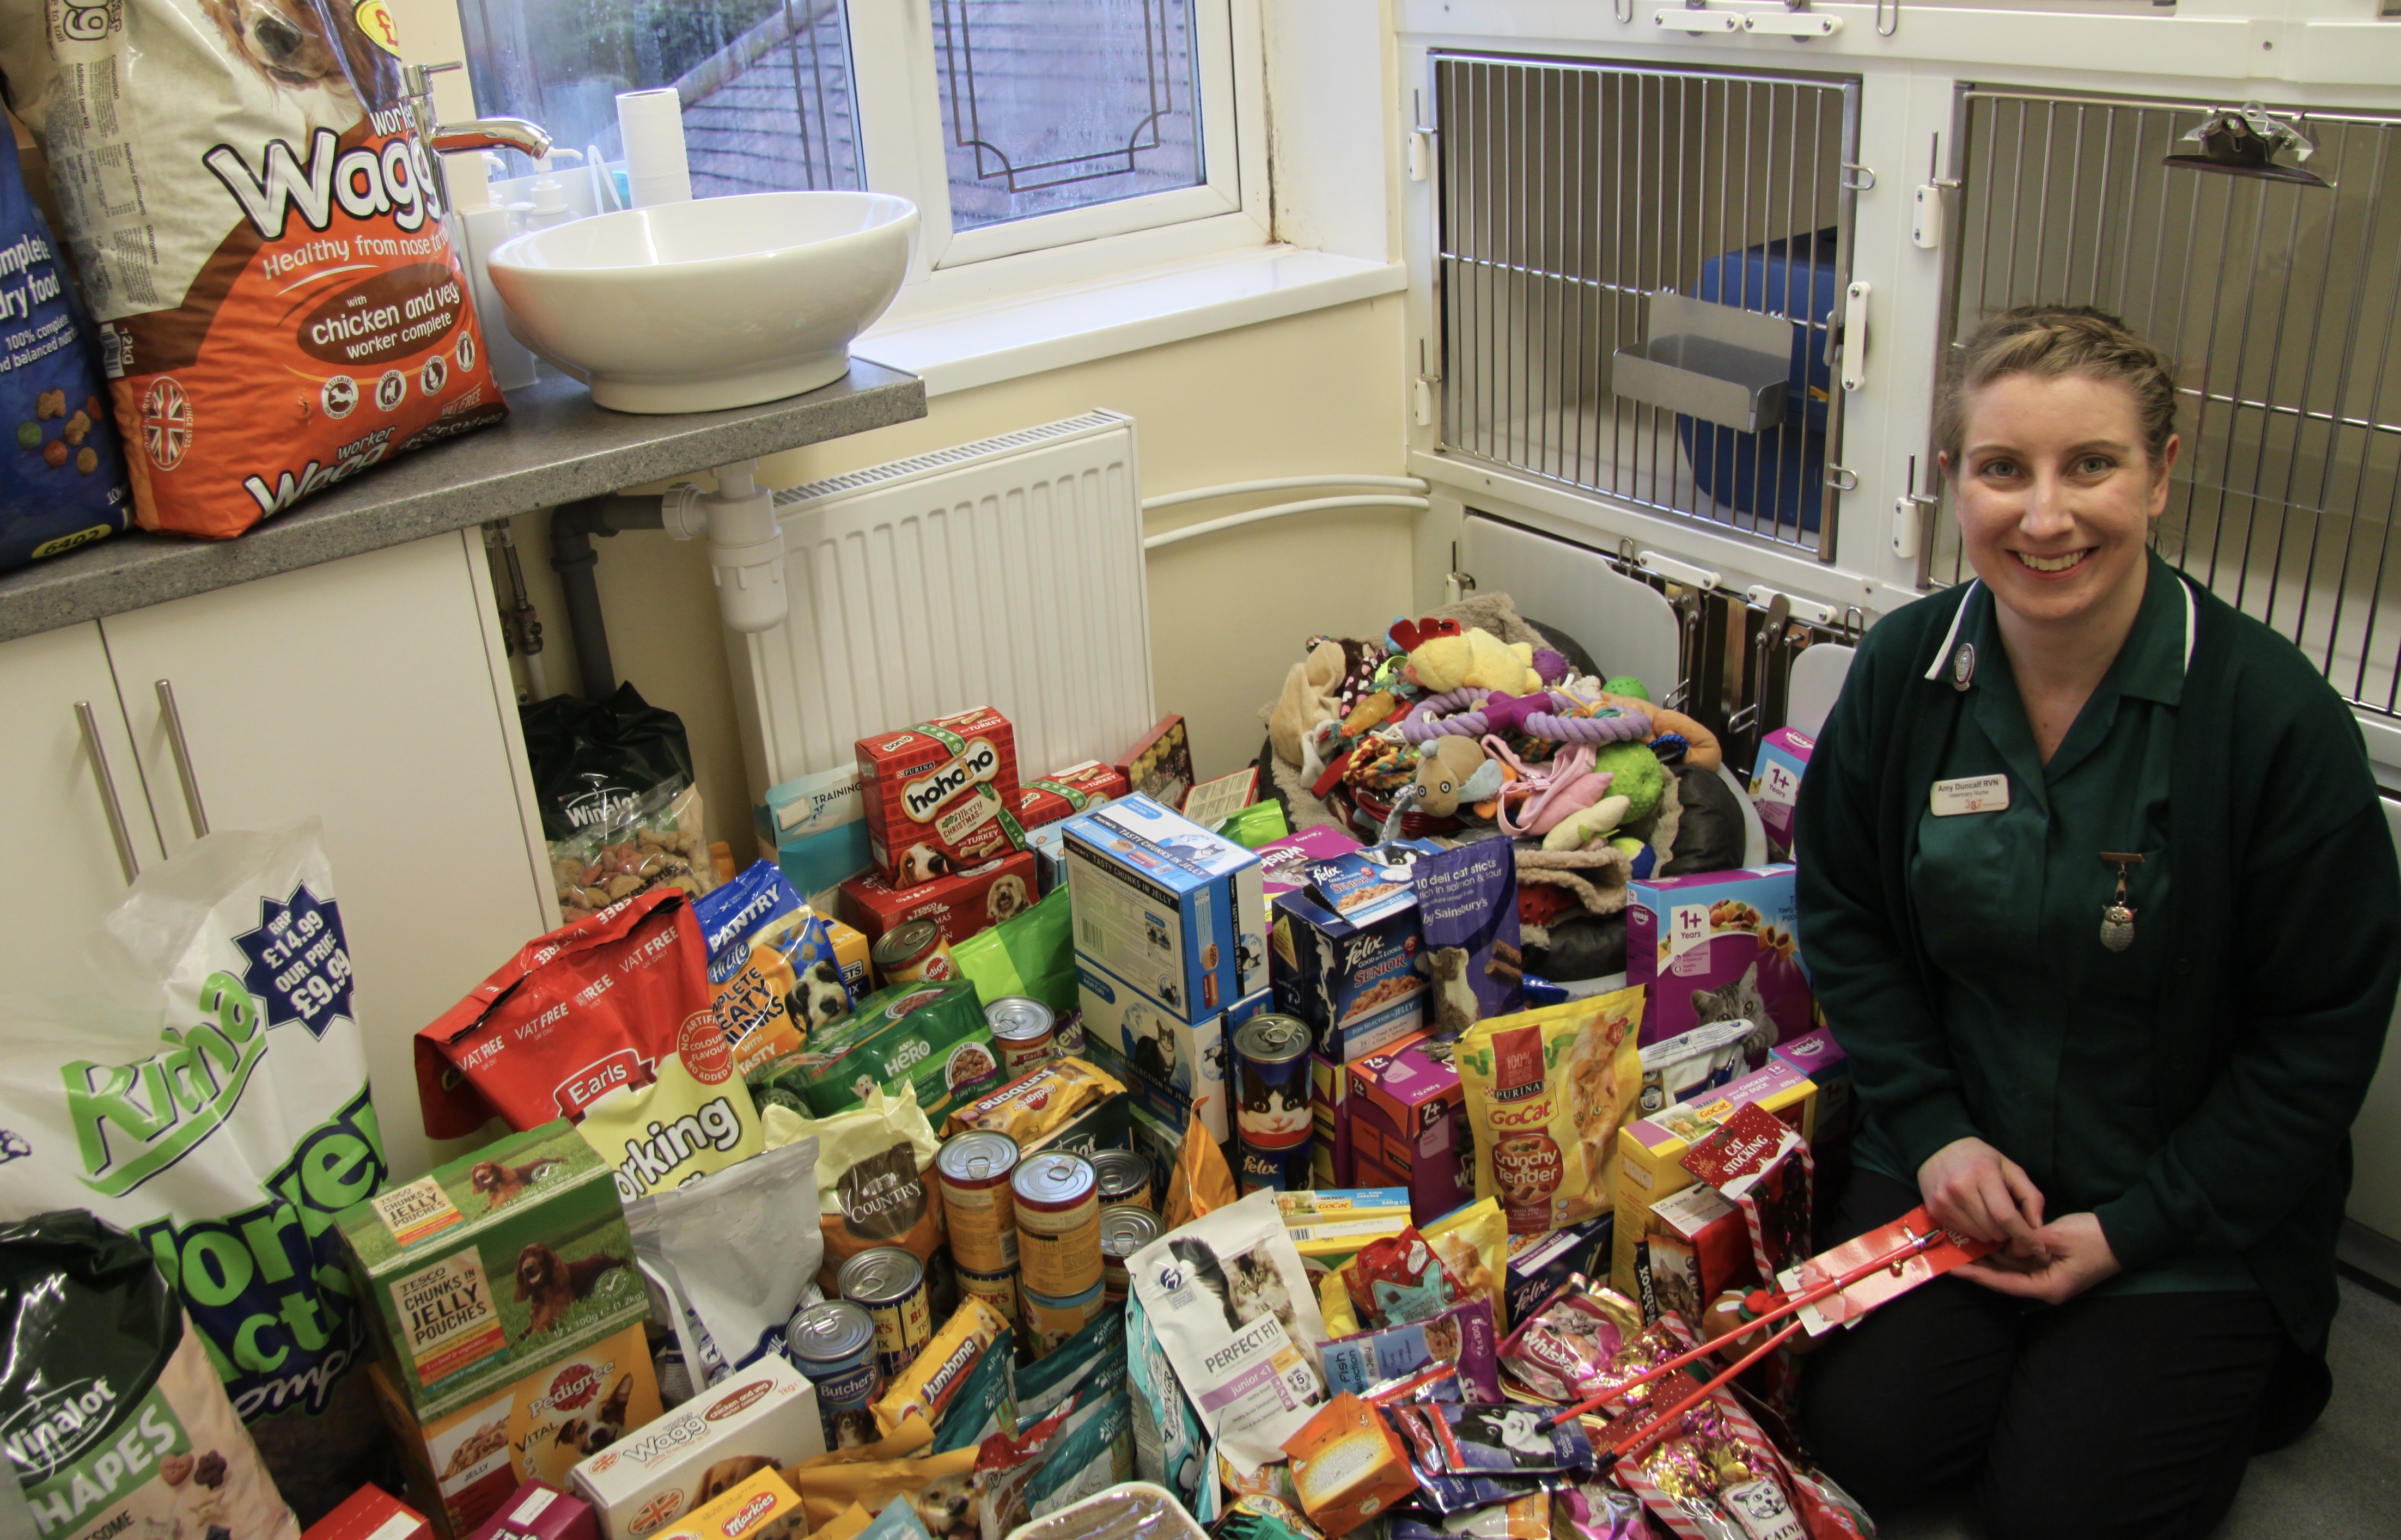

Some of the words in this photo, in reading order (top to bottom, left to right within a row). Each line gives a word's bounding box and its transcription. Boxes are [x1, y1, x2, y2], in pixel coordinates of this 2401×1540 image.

[202, 127, 442, 240] Wagg
[147, 225, 159, 265] Guarantee
[263, 239, 350, 280] Healthy
[355, 235, 399, 256] from
[400, 239, 431, 256] nose
[27, 268, 60, 304] food
[312, 304, 400, 345] chicken
[405, 288, 436, 320] and
[435, 280, 460, 305] veg
[347, 295, 368, 308] with
[5, 329, 36, 351] 100%
[36, 314, 70, 339] complete
[346, 331, 398, 359] worker
[402, 312, 452, 343] complete
[13, 337, 59, 368] balanced
[119, 328, 135, 365] 12kg
[330, 376, 354, 388] VITAMINS
[381, 371, 400, 382] STAMINA
[142, 391, 151, 410] MADE
[459, 387, 482, 414] FREE
[184, 402, 193, 427] SINCE
[184, 428, 193, 449] 1923
[338, 425, 397, 461] worker
[44, 529, 100, 555] 6402
[968, 718, 1002, 733] TURKEY
[905, 762, 934, 776] PURINA
[1088, 774, 1117, 788] TURKEY
[1772, 768, 1790, 789] 1+
[812, 781, 863, 806] TRAINING
[1769, 783, 1787, 799] Years
[954, 800, 983, 820] Merry
[943, 811, 982, 838] CHRISTMAS
[966, 829, 999, 846] TURKEY
[1119, 828, 1142, 845] TASTY
[1140, 840, 1173, 859] CHUNKS
[1170, 855, 1181, 864] IN
[1179, 861, 1206, 877] JELLY
[1092, 855, 1113, 871] TASTY
[1113, 867, 1141, 887] CHUNKS
[1142, 883, 1150, 894] IN
[1151, 888, 1172, 905] JELLY
[1313, 864, 1342, 886] felix
[1330, 875, 1373, 894] SENIOR
[1415, 878, 1428, 890] 10
[1429, 872, 1451, 886] deli
[1453, 866, 1468, 881] cat
[1470, 859, 1497, 874] sticks
[1419, 888, 1434, 900] rich
[1435, 885, 1444, 894] in
[1446, 877, 1476, 893] salmon
[1477, 873, 1485, 883] &
[268, 909, 292, 936] RRP
[596, 896, 633, 925] FREE
[709, 883, 783, 954] PANTRY
[912, 902, 937, 916] TESCO
[1423, 912, 1435, 927] by
[1434, 897, 1488, 920] Sainsbury's
[1679, 909, 1702, 930] 1+
[262, 910, 324, 969] £14.99
[1680, 930, 1702, 940] Years
[533, 940, 568, 966] FREE
[619, 949, 643, 974] VAT
[643, 925, 680, 956] FREE
[642, 961, 653, 970] UK
[651, 949, 668, 964] ONLY
[1344, 935, 1383, 976] felix
[1358, 957, 1375, 968] GOOD
[275, 957, 310, 993] OUR
[290, 948, 352, 1019] £9.99
[1354, 954, 1408, 988] SENIOR
[584, 973, 615, 999] FREE
[514, 1018, 541, 1041] VAT
[539, 1001, 570, 1029] FREE
[1363, 1016, 1390, 1030] SELECTION
[1393, 1001, 1415, 1018] JELLY
[455, 1049, 483, 1073] VAT
[480, 1035, 505, 1059] FREE
[681, 1033, 690, 1051] NO
[741, 1034, 764, 1053] WITH
[898, 1038, 916, 1053] ASDA
[1022, 1050, 1044, 1061] Earls
[687, 1060, 699, 1075] NO
[698, 1068, 728, 1082] ADDED
[739, 1042, 777, 1075] TASTY
[1363, 1056, 1384, 1068] 7+
[1506, 1051, 1533, 1070] 100%
[1768, 1064, 1781, 1074] 1+
[566, 1062, 629, 1107] Earls
[979, 1066, 1056, 1110] Jumbone
[1013, 1082, 1058, 1111] Pedigree
[1495, 1081, 1541, 1099] PURINA
[1732, 1091, 1749, 1101] AND
[1748, 1083, 1770, 1095] DUCK
[1739, 1075, 1770, 1091] CHICKEN
[1422, 1102, 1441, 1120] 7+
[1424, 1114, 1441, 1126] Years
[1489, 1098, 1552, 1127] GoCat
[1699, 1102, 1729, 1119] GoCat
[1494, 1149, 1558, 1168] Crunchy
[1722, 1133, 1769, 1176] STOCKING
[1724, 1136, 1745, 1157] CAT
[1243, 1155, 1281, 1175] felix
[1496, 1163, 1558, 1184] Tender
[382, 1190, 425, 1213] CHUNKS
[425, 1185, 435, 1194] IN
[389, 1192, 439, 1221] JELLY
[850, 1176, 923, 1224] COUNTRY
[392, 1200, 447, 1227] POUCHES
[399, 1267, 447, 1293] TESCO
[404, 1276, 464, 1311] CHUNKS
[464, 1267, 476, 1280] IN
[412, 1282, 478, 1333] JELLY
[612, 1290, 646, 1312] (1.2kg)
[1514, 1278, 1551, 1322] felix
[415, 1301, 487, 1346] POUCHES
[574, 1311, 600, 1332] 100g
[1204, 1329, 1264, 1374] PERFECT
[1259, 1318, 1279, 1339] FIT
[1364, 1346, 1374, 1367] Jelly
[1522, 1330, 1580, 1380] whiskas
[922, 1339, 977, 1405] Jumbone
[1230, 1373, 1259, 1397] junior
[1260, 1365, 1272, 1378] <1
[1336, 1352, 1351, 1384] Fish
[527, 1360, 617, 1420] Pedigree
[777, 1383, 796, 1397] 1kg
[820, 1370, 875, 1397] Butcher's
[710, 1398, 739, 1419] chicken
[739, 1389, 754, 1403] and
[753, 1382, 770, 1395] veg
[1105, 1406, 1126, 1426] Penlan
[513, 1421, 560, 1453] VITAL
[623, 1416, 708, 1463] Wagg
[27, 1403, 177, 1536] HAPES
[463, 1462, 489, 1482] JELLY
[726, 1493, 775, 1537] Markies
